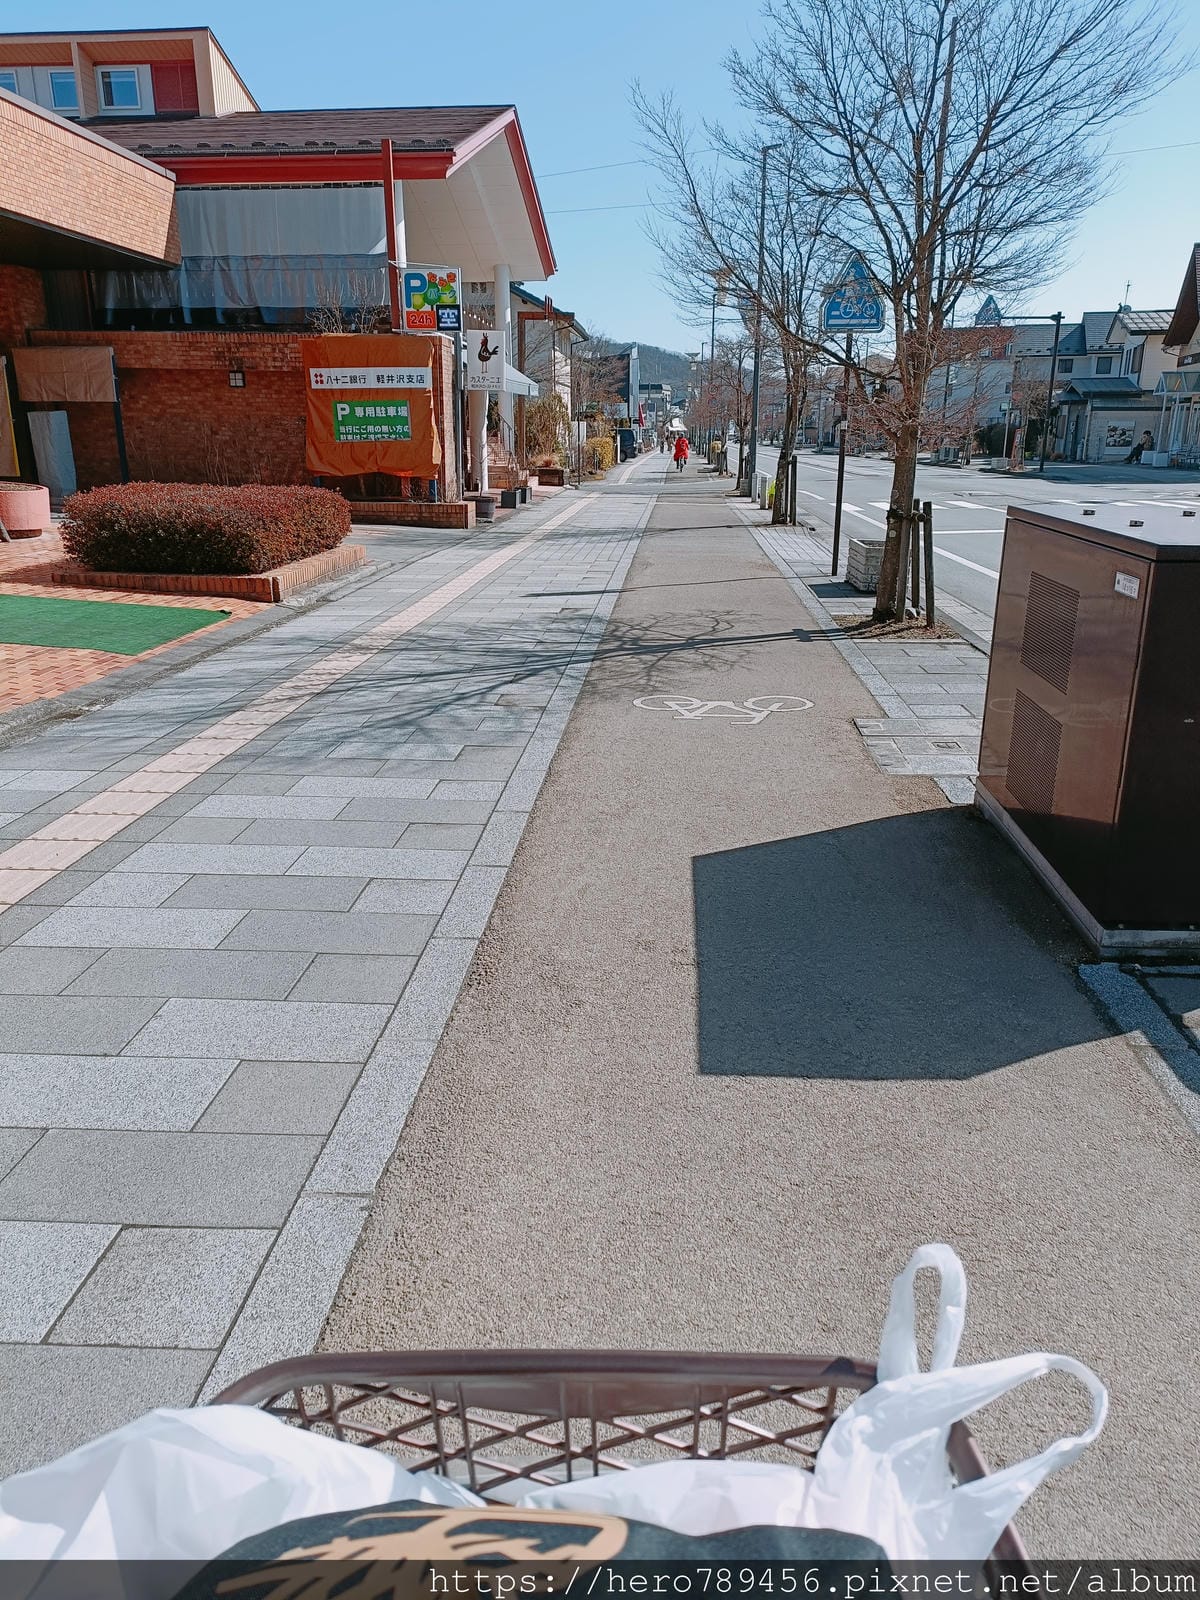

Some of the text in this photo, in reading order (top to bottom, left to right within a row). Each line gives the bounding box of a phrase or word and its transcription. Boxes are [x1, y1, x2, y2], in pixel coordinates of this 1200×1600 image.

[427, 272, 457, 287] なみき
[404, 272, 427, 308] P
[410, 314, 432, 325] 24h
[326, 374, 425, 385] 八十二銀行 軽井沢支店
[336, 404, 408, 421] P 専用駐車場
